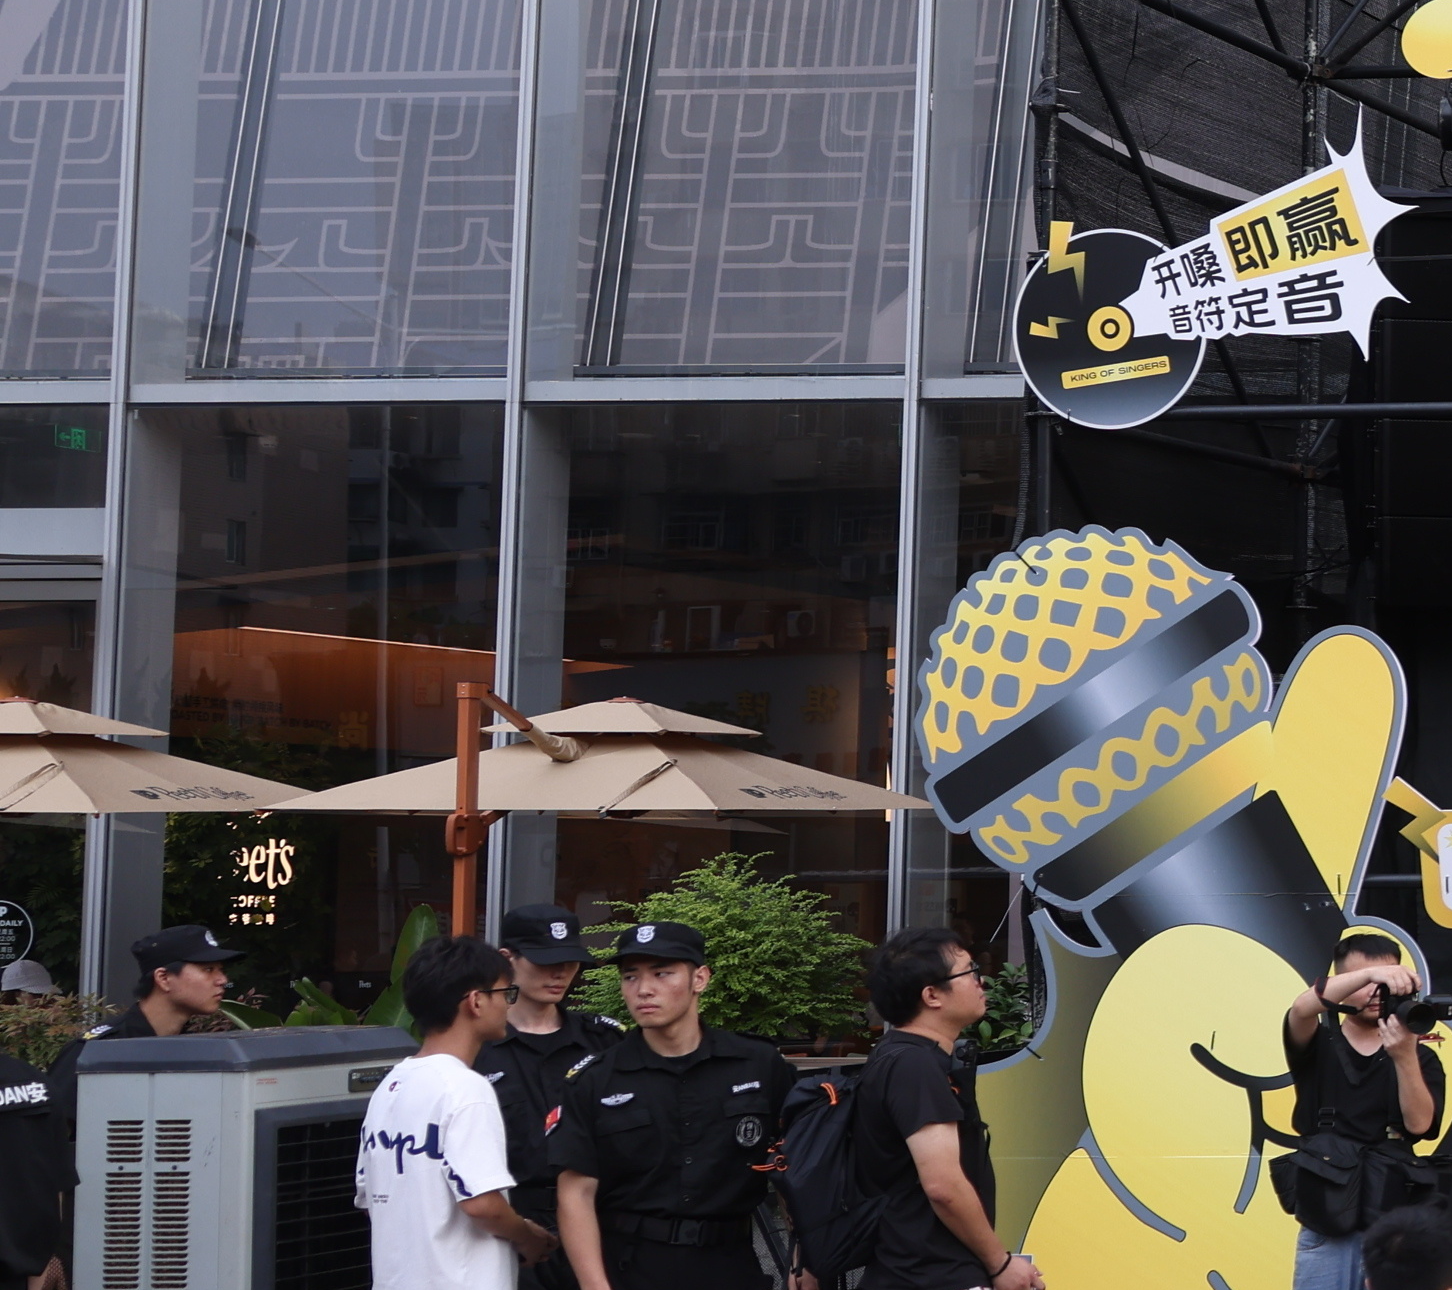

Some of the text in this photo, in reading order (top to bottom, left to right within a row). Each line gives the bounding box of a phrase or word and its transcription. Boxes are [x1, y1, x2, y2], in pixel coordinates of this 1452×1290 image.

[1168, 268, 1345, 336] 音符定音
[1070, 359, 1168, 383] KING OF SINGERS
